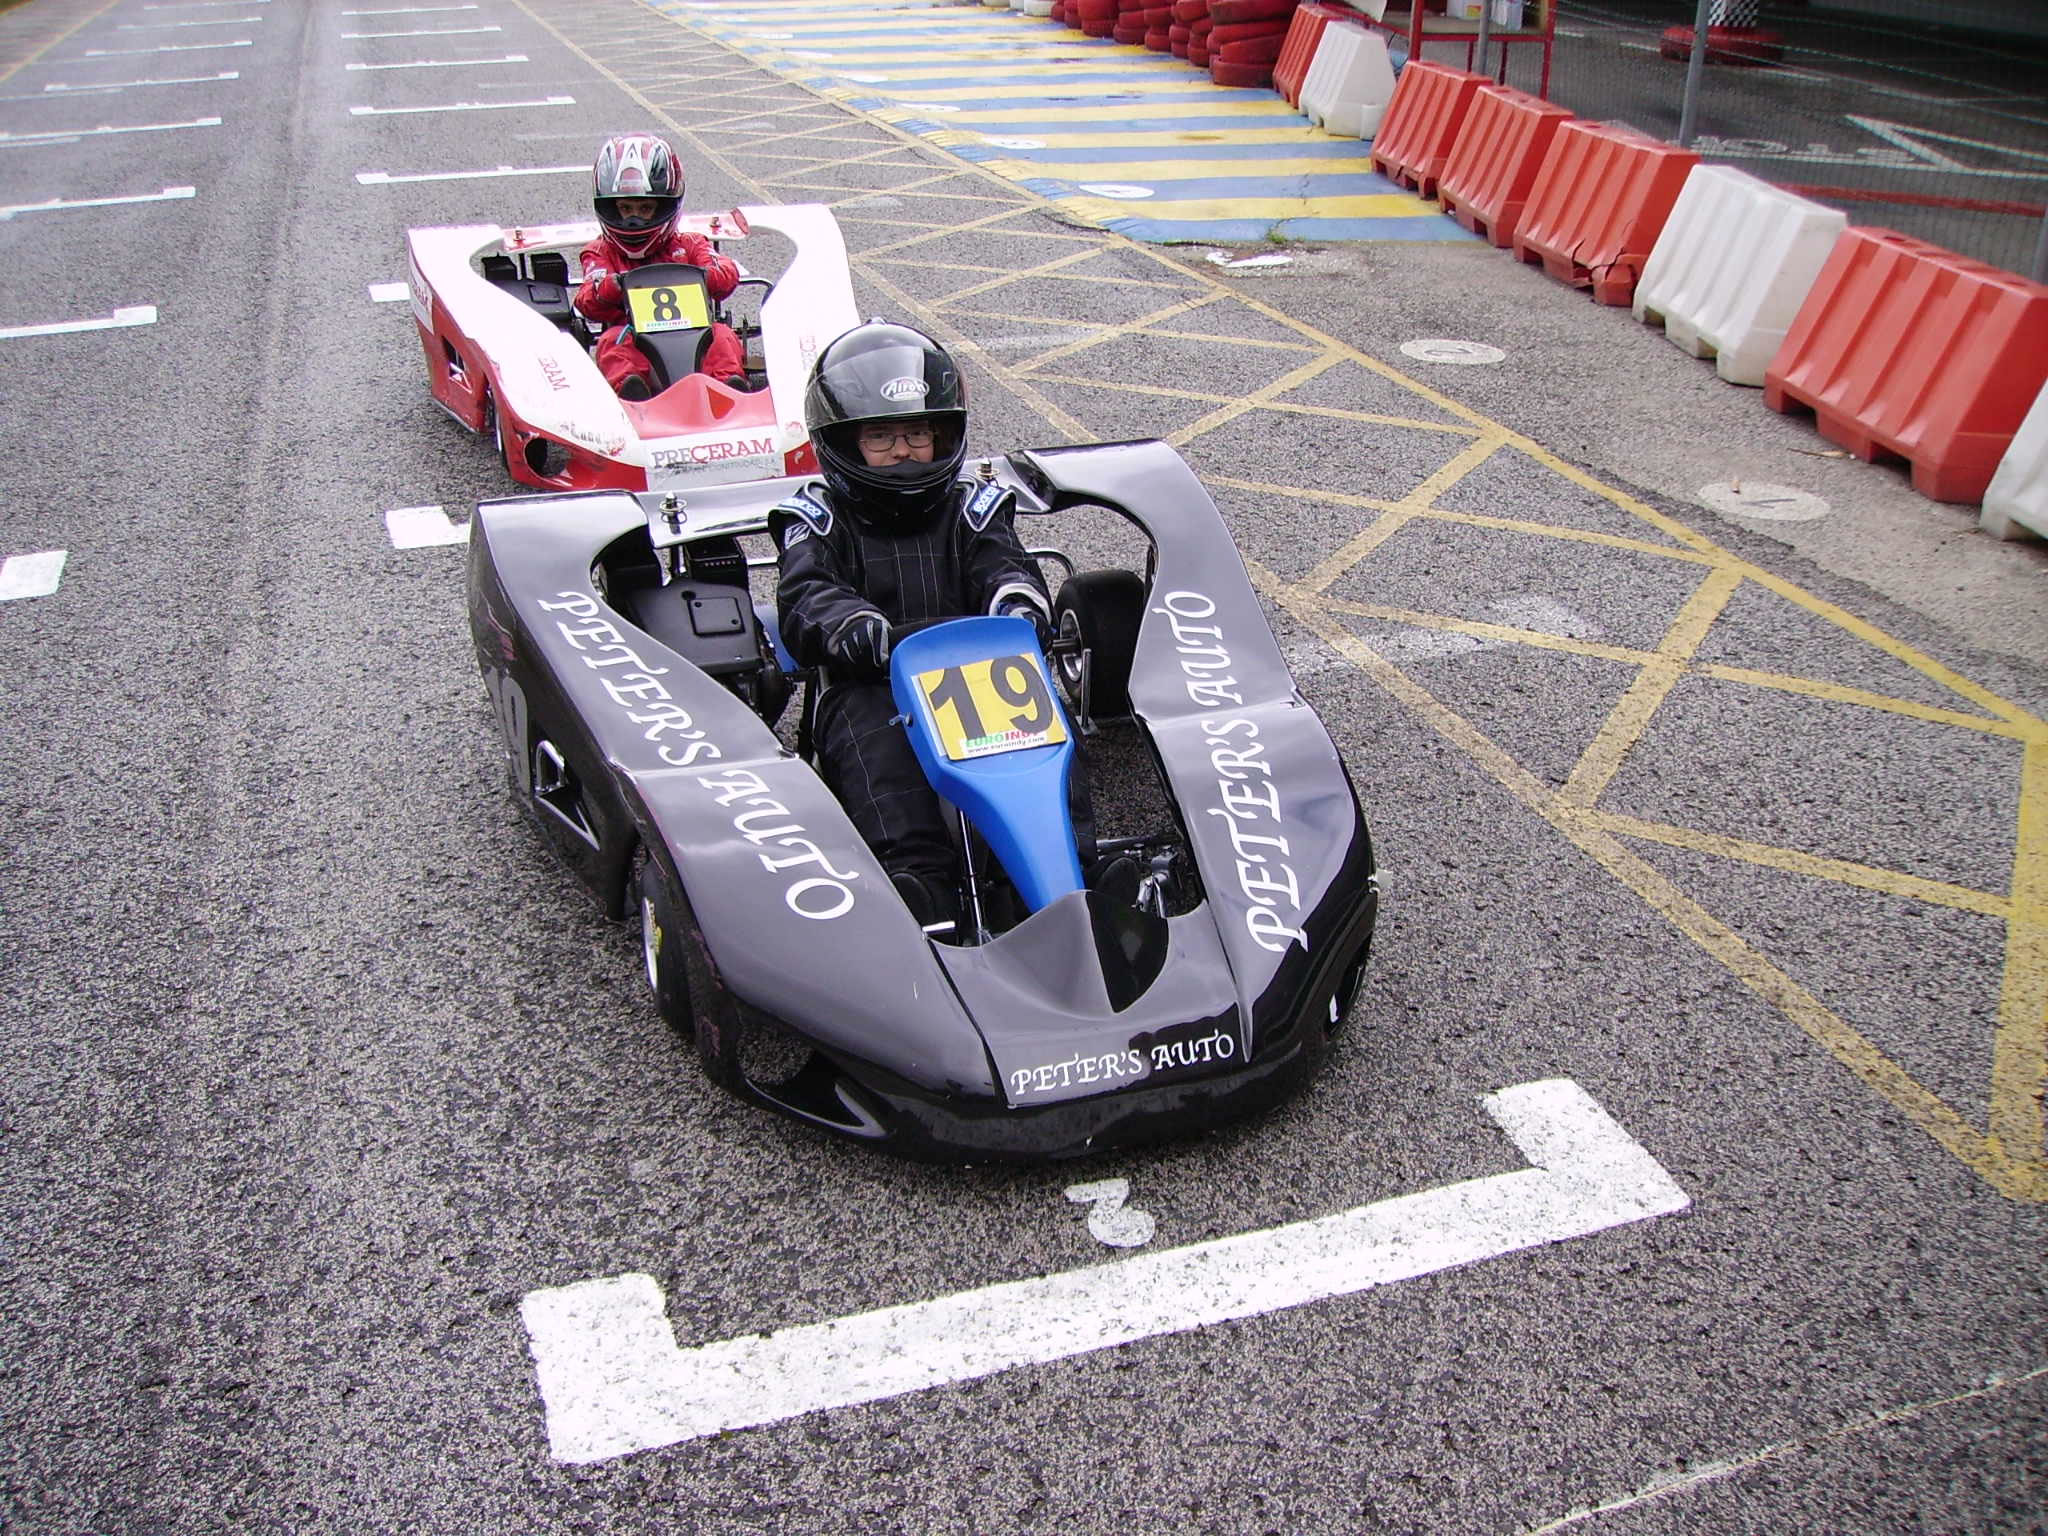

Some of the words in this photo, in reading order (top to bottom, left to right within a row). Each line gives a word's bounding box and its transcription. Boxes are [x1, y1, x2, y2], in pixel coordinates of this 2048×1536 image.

[651, 287, 682, 322] 8
[929, 655, 1053, 741] 19
[1151, 591, 1244, 708] AUTO
[537, 591, 722, 767] PETER'S
[697, 770, 860, 920] AUTO
[1201, 719, 1308, 953] PETER'S
[1010, 1048, 1143, 1096] PETER'S
[1150, 1028, 1235, 1071] AUTO
